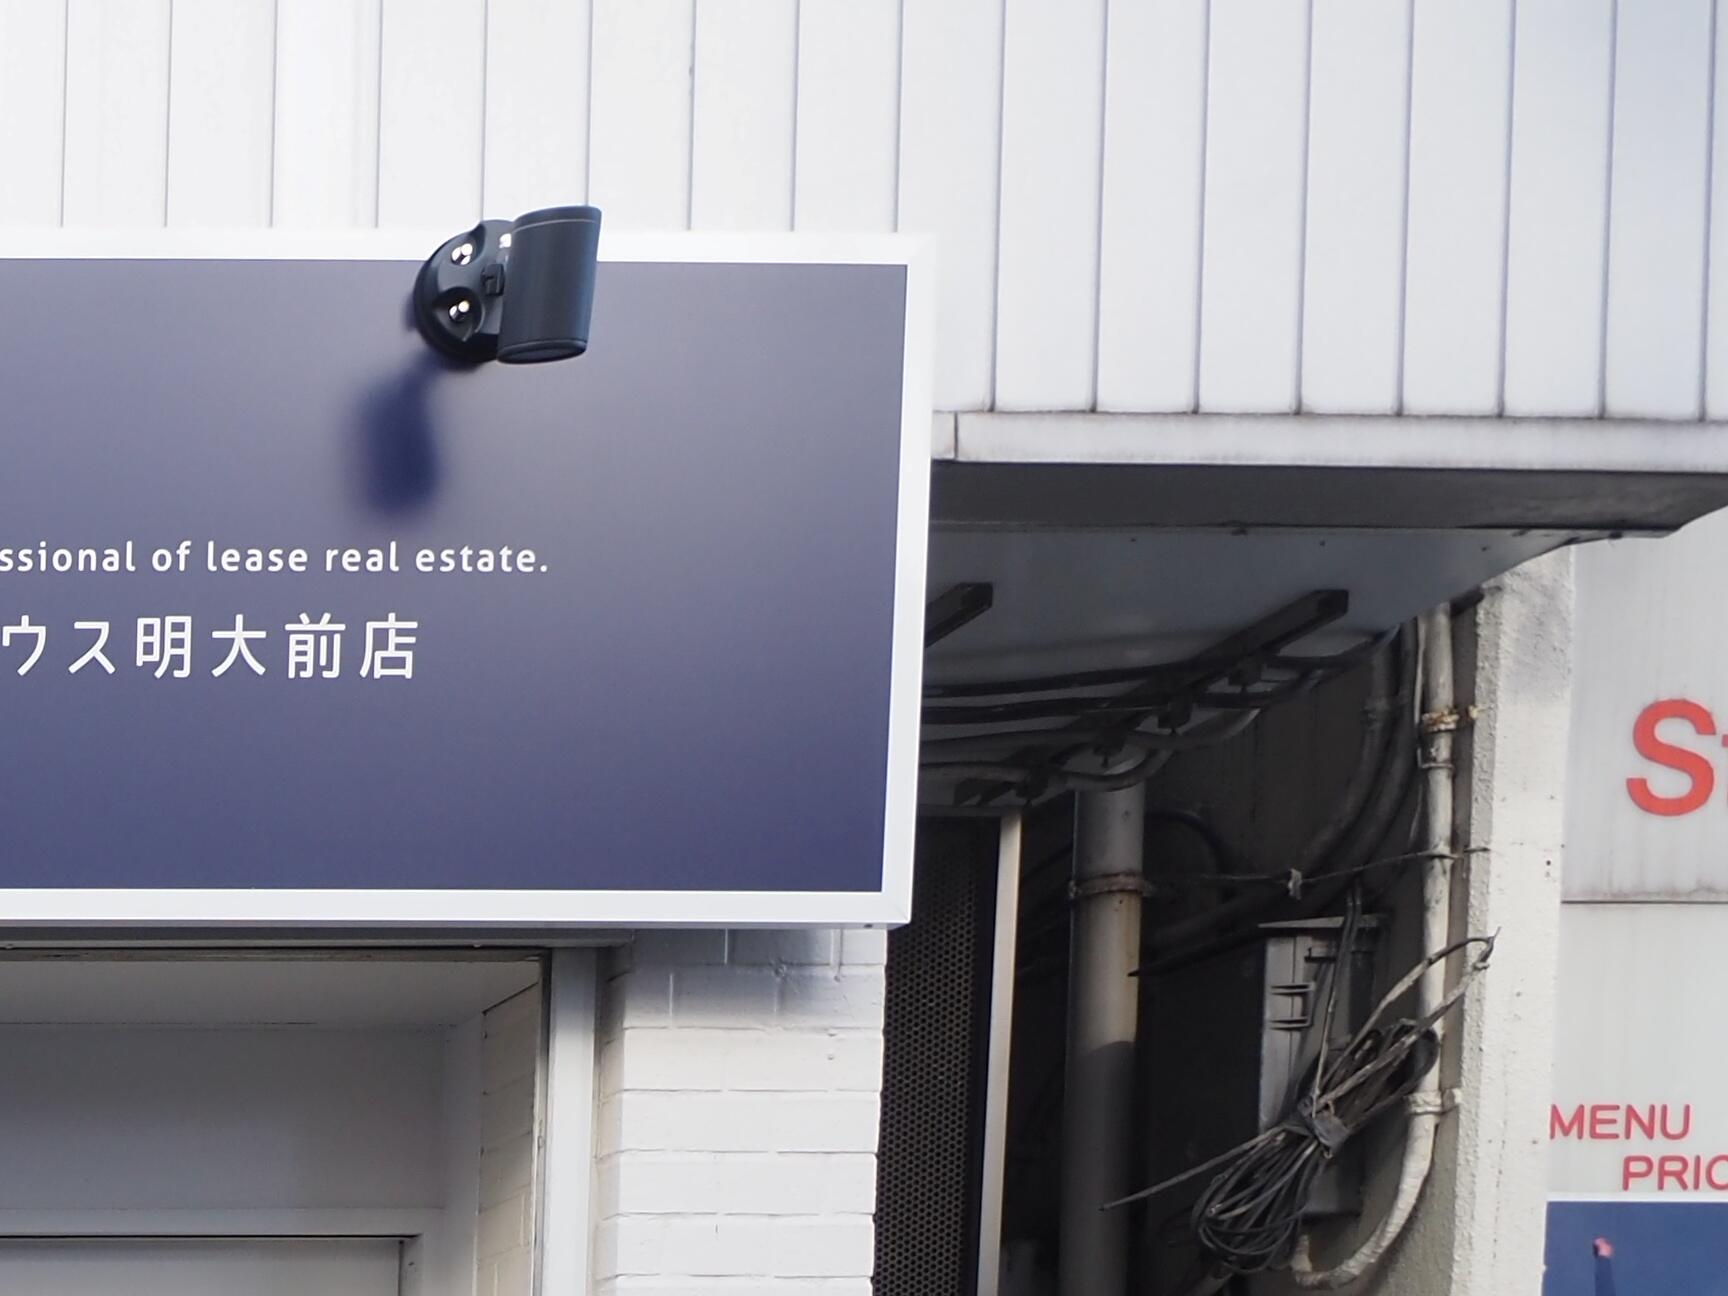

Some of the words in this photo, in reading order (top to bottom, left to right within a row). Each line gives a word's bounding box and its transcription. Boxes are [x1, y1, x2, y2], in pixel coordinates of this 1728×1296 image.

[151, 540, 192, 572] of
[207, 540, 308, 572] lease
[325, 540, 400, 572] real
[415, 545, 548, 573] estate.
[1625, 698, 1728, 817] S
[1548, 1103, 1691, 1141] MENU
